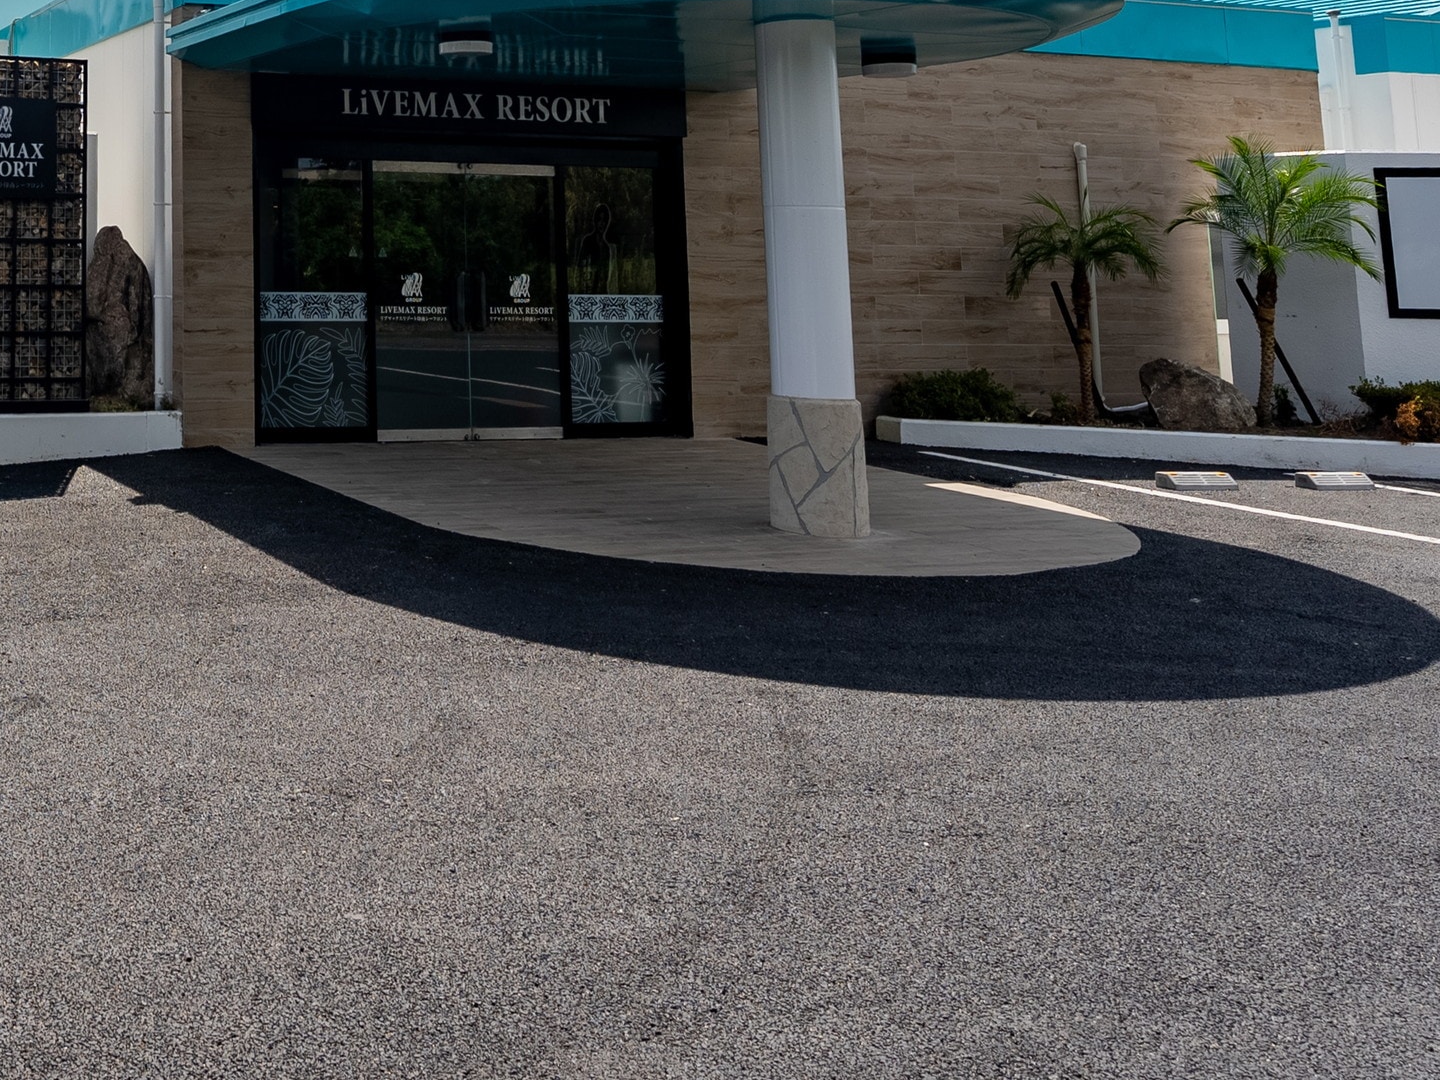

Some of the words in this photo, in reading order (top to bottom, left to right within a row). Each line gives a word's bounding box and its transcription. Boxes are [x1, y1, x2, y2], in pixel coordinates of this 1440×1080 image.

[341, 88, 485, 119] LiVEMAX
[496, 94, 610, 124] RESORT
[417, 306, 447, 315] RESORT
[525, 306, 555, 315] RESORT
